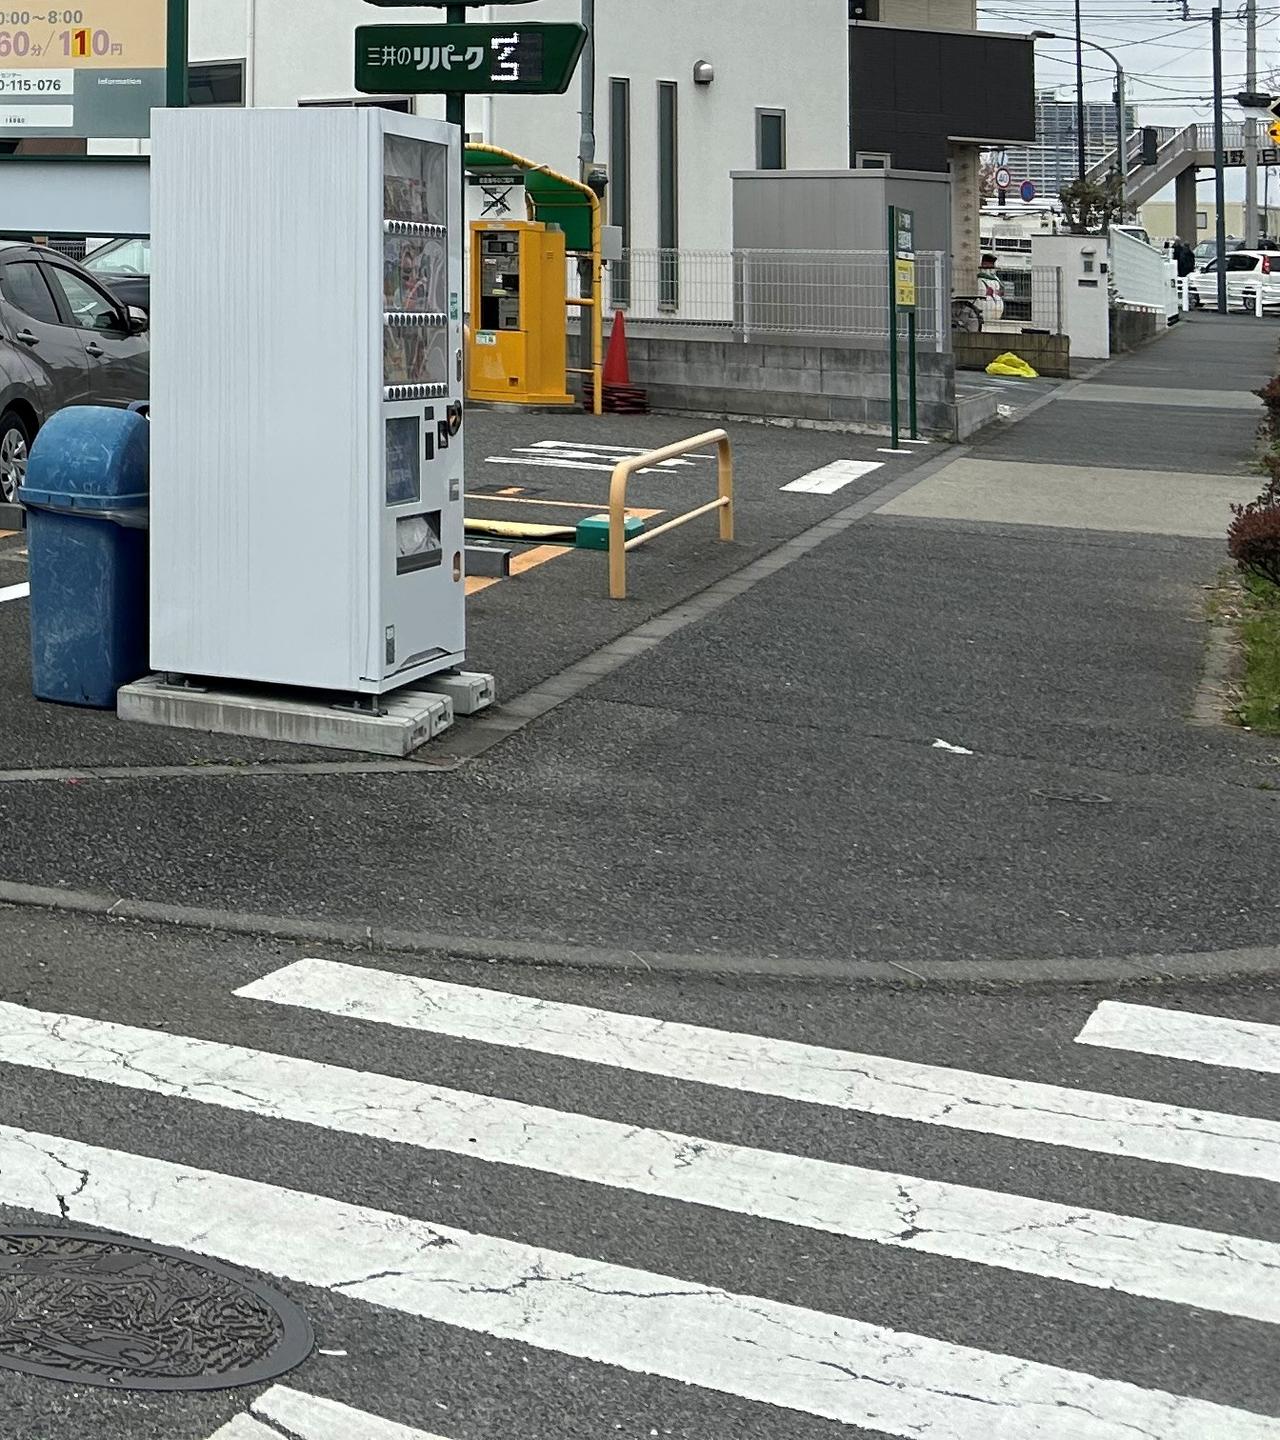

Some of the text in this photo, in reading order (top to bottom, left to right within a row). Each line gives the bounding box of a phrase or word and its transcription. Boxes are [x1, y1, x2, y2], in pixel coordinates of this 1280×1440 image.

[366, 44, 484, 71] 三井のリパーク
